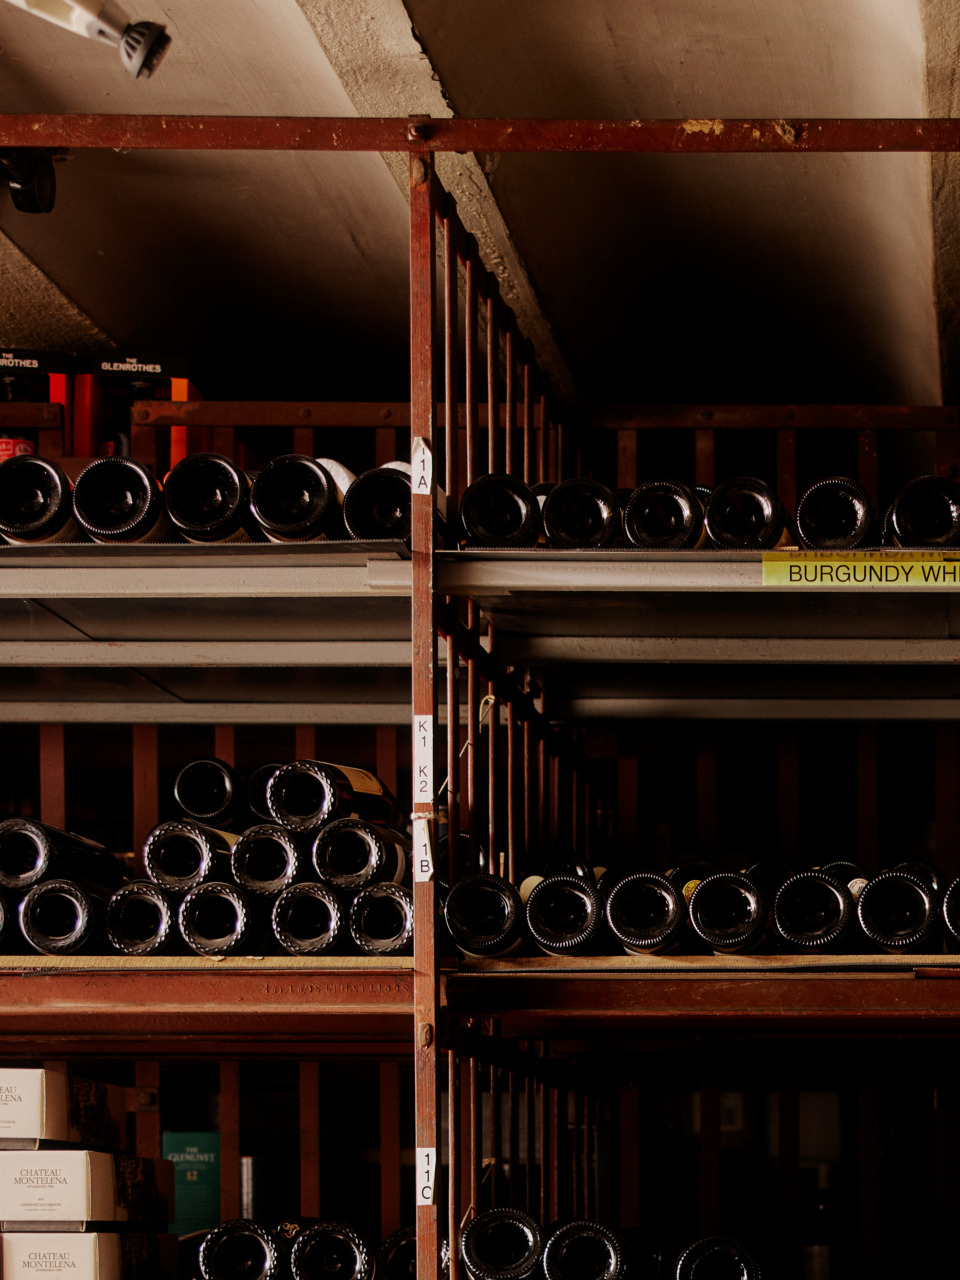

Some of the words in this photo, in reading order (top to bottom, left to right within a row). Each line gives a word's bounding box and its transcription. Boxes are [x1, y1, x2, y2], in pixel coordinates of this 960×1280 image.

[0, 357, 40, 370] ROTHES
[101, 361, 162, 374] GLENROTHES
[788, 564, 914, 583] BURGUNDY
[418, 720, 428, 748] K1
[418, 765, 429, 793] K2
[420, 842, 431, 873] 1B
[20, 1169, 62, 1177] CHATEAU
[421, 1153, 432, 1200] 11C
[14, 1177, 68, 1185] MONTELENA
[28, 1252, 70, 1260] CHATEAU
[22, 1260, 76, 1268] MONTELENA
